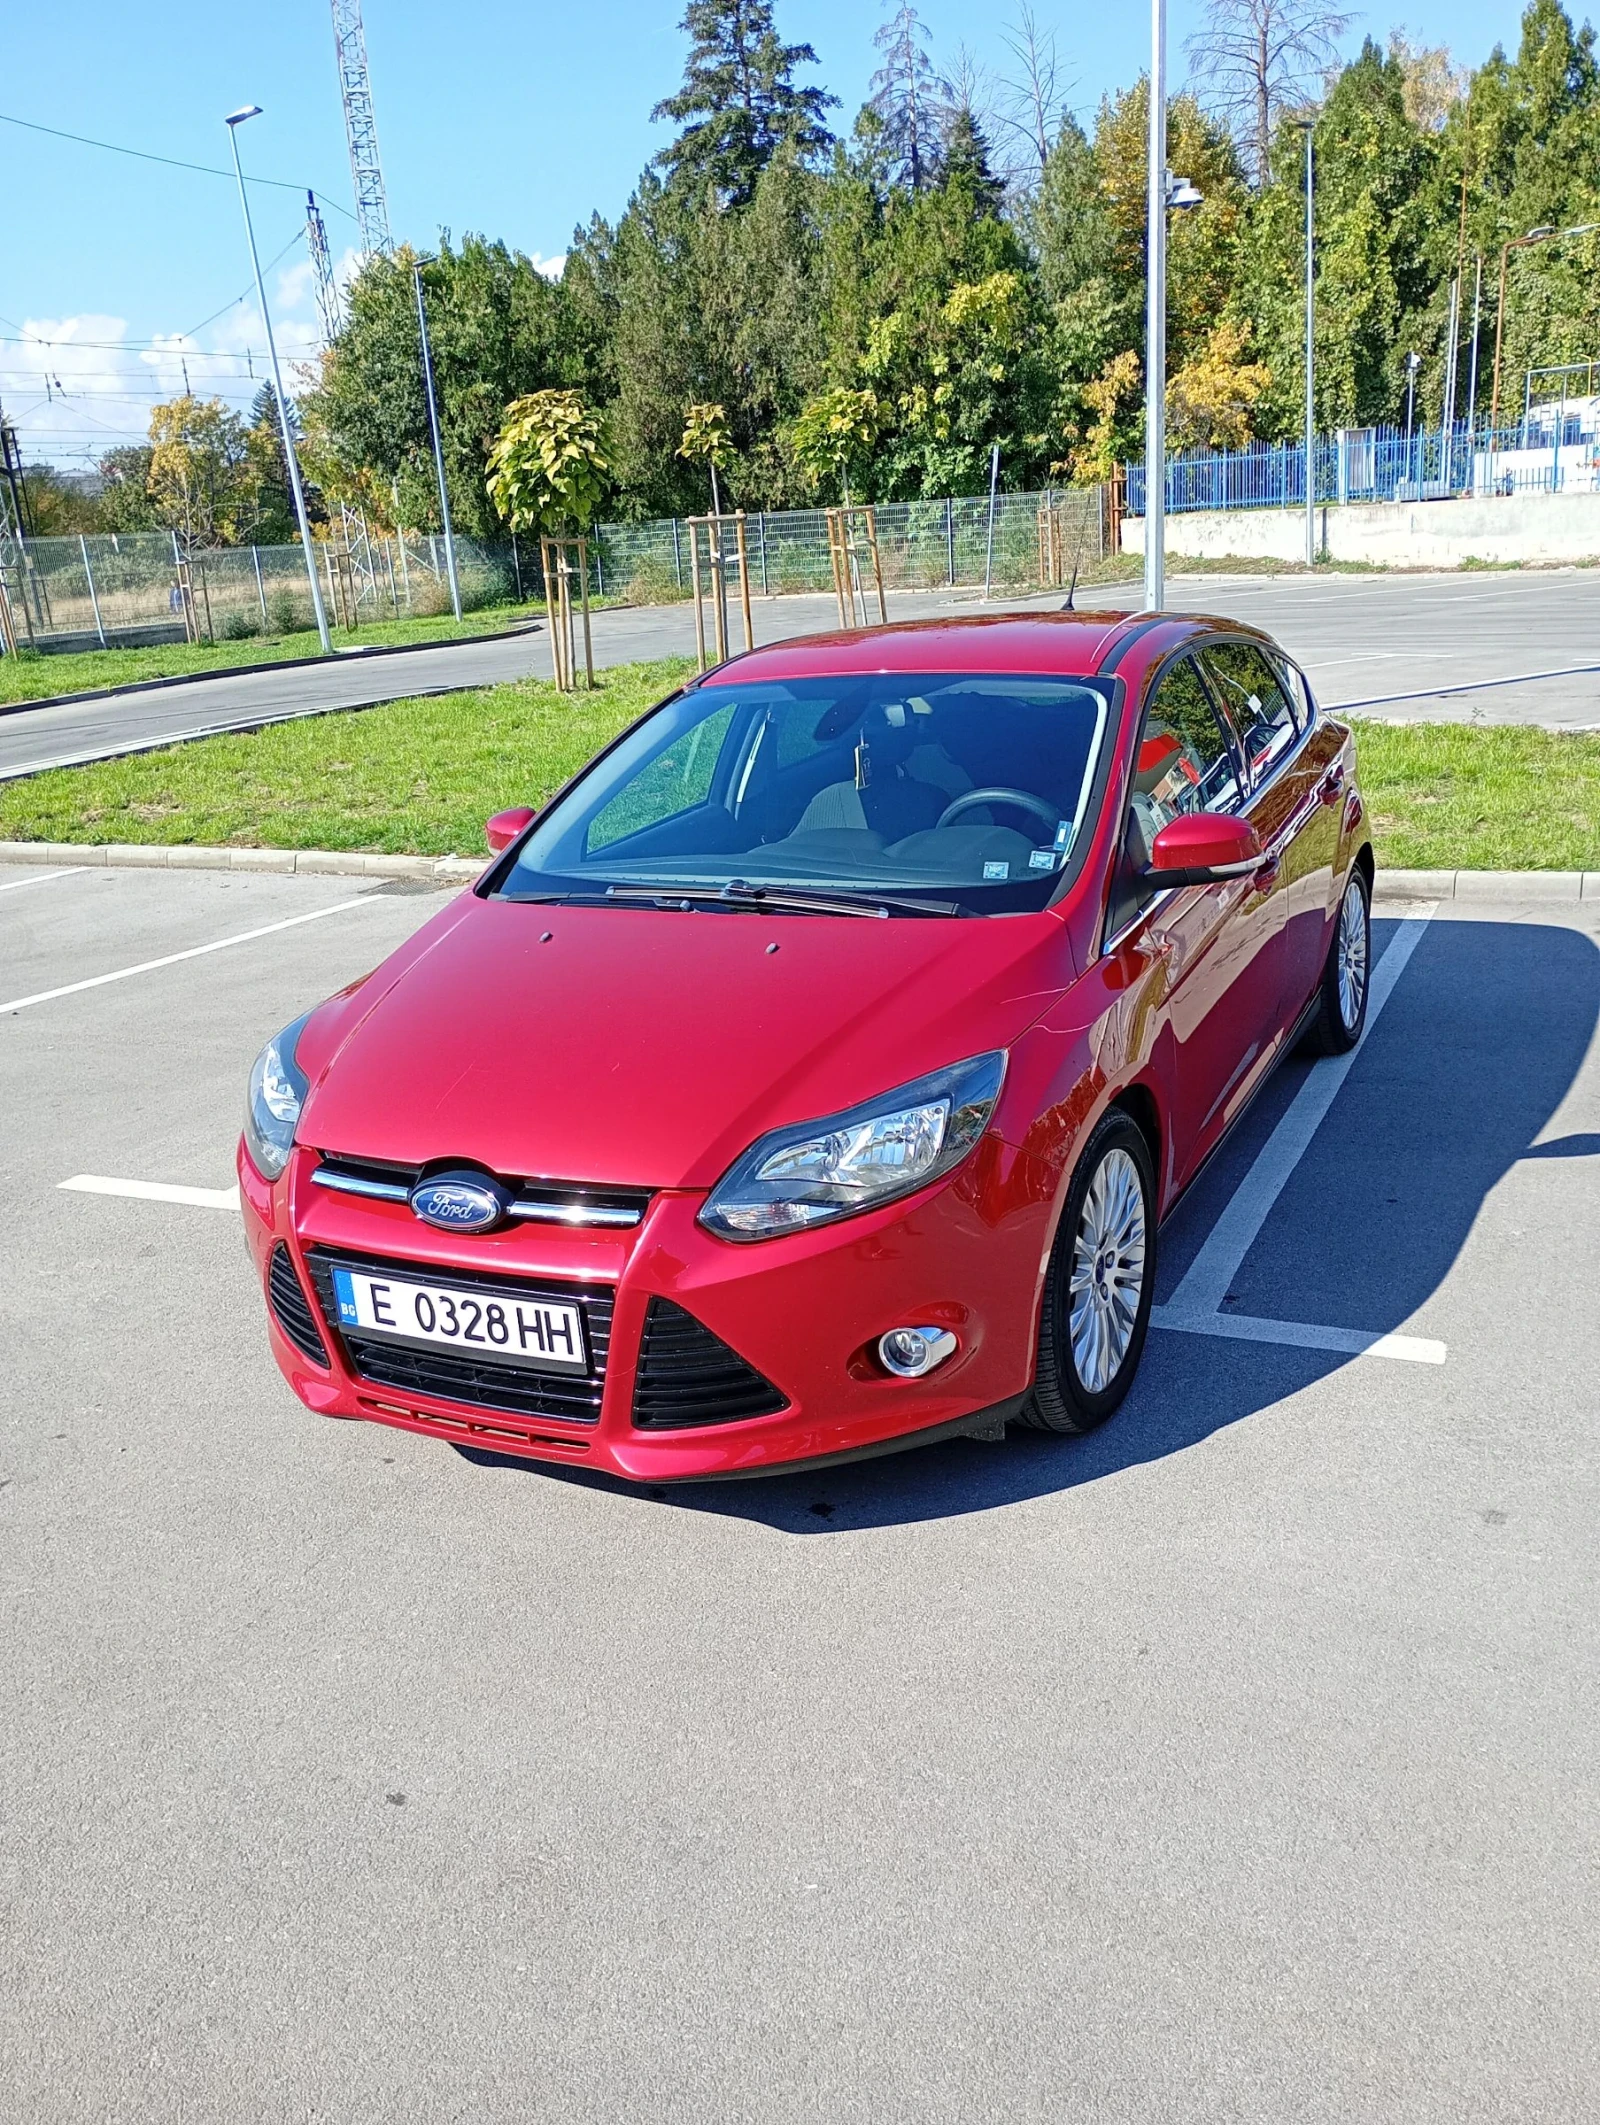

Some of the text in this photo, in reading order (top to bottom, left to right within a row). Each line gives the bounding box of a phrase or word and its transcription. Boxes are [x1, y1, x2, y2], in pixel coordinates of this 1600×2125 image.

[427, 1191, 474, 1219] Ford
[340, 1303, 356, 1317] BG
[369, 1283, 396, 1326] E
